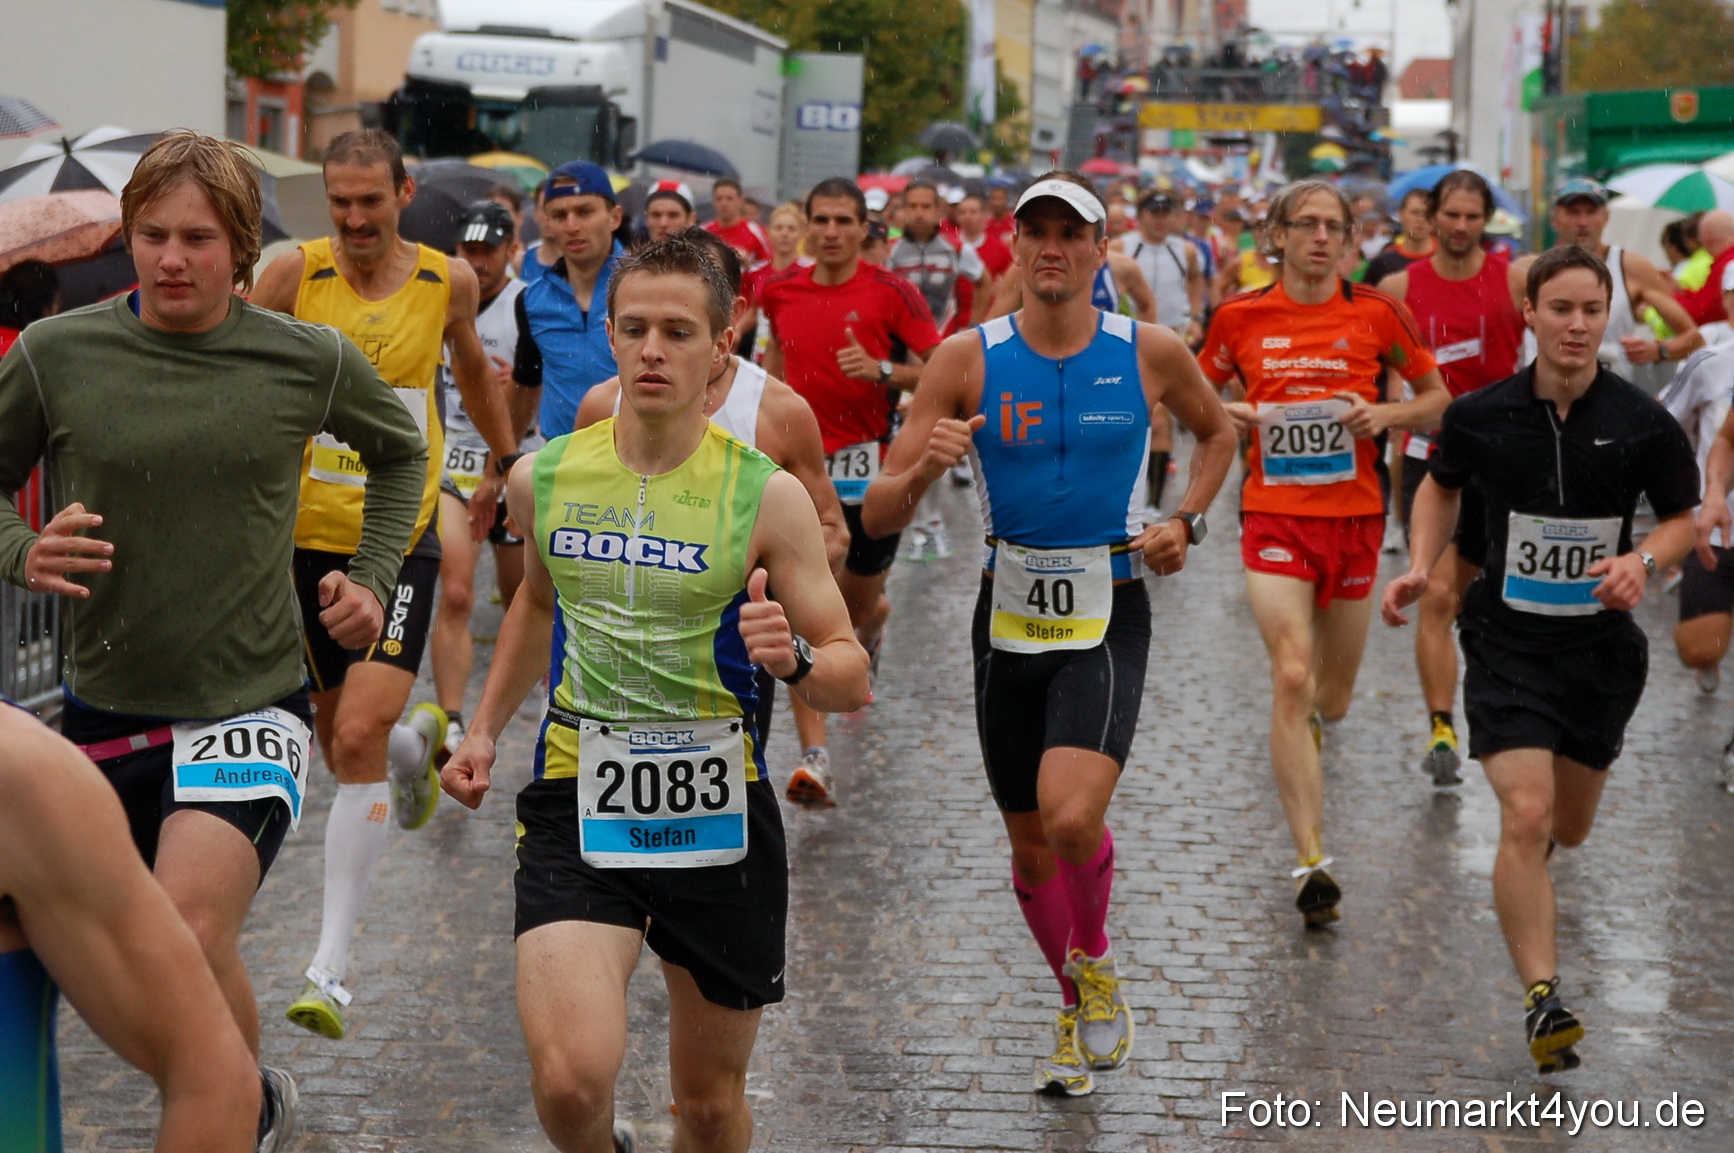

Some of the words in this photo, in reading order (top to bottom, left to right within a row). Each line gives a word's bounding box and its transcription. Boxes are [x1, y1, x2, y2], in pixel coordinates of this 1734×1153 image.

[1262, 356, 1348, 372] SportScheck
[1269, 421, 1344, 455] 2092
[338, 455, 368, 473] Tho
[564, 502, 655, 530] TEAM
[549, 527, 710, 574] BOCK
[1025, 555, 1072, 568] BOCK
[1027, 578, 1074, 617] 40
[387, 584, 414, 641] SKINS
[1026, 622, 1074, 640] Stefan
[629, 730, 694, 745] BOCK
[191, 727, 302, 780] 2066
[214, 767, 290, 790] Andreas
[596, 757, 730, 815] 2083
[629, 826, 696, 848] Stefan
